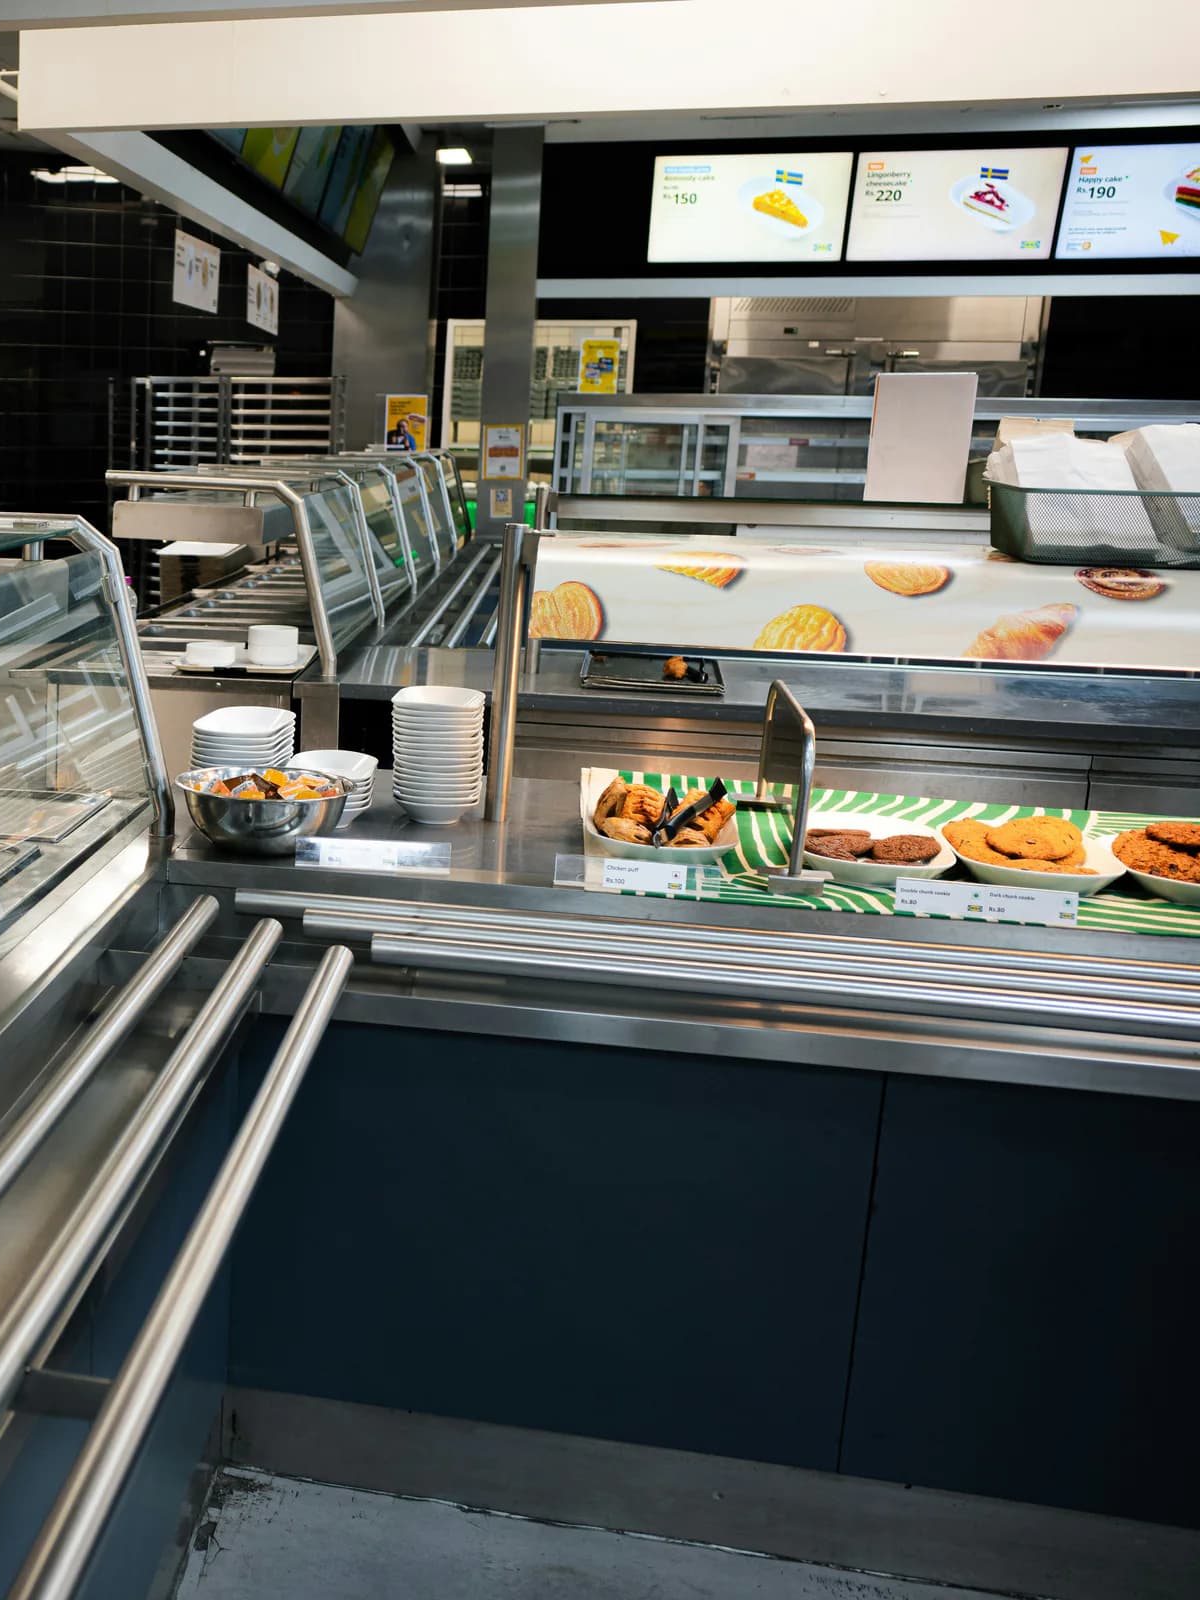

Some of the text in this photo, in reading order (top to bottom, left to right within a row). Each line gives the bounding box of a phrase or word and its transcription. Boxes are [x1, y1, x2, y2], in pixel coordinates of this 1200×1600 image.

[1079, 176, 1102, 184] Happy
[876, 190, 902, 202] 220
[1089, 186, 1116, 199] 190
[674, 193, 697, 205] 150
